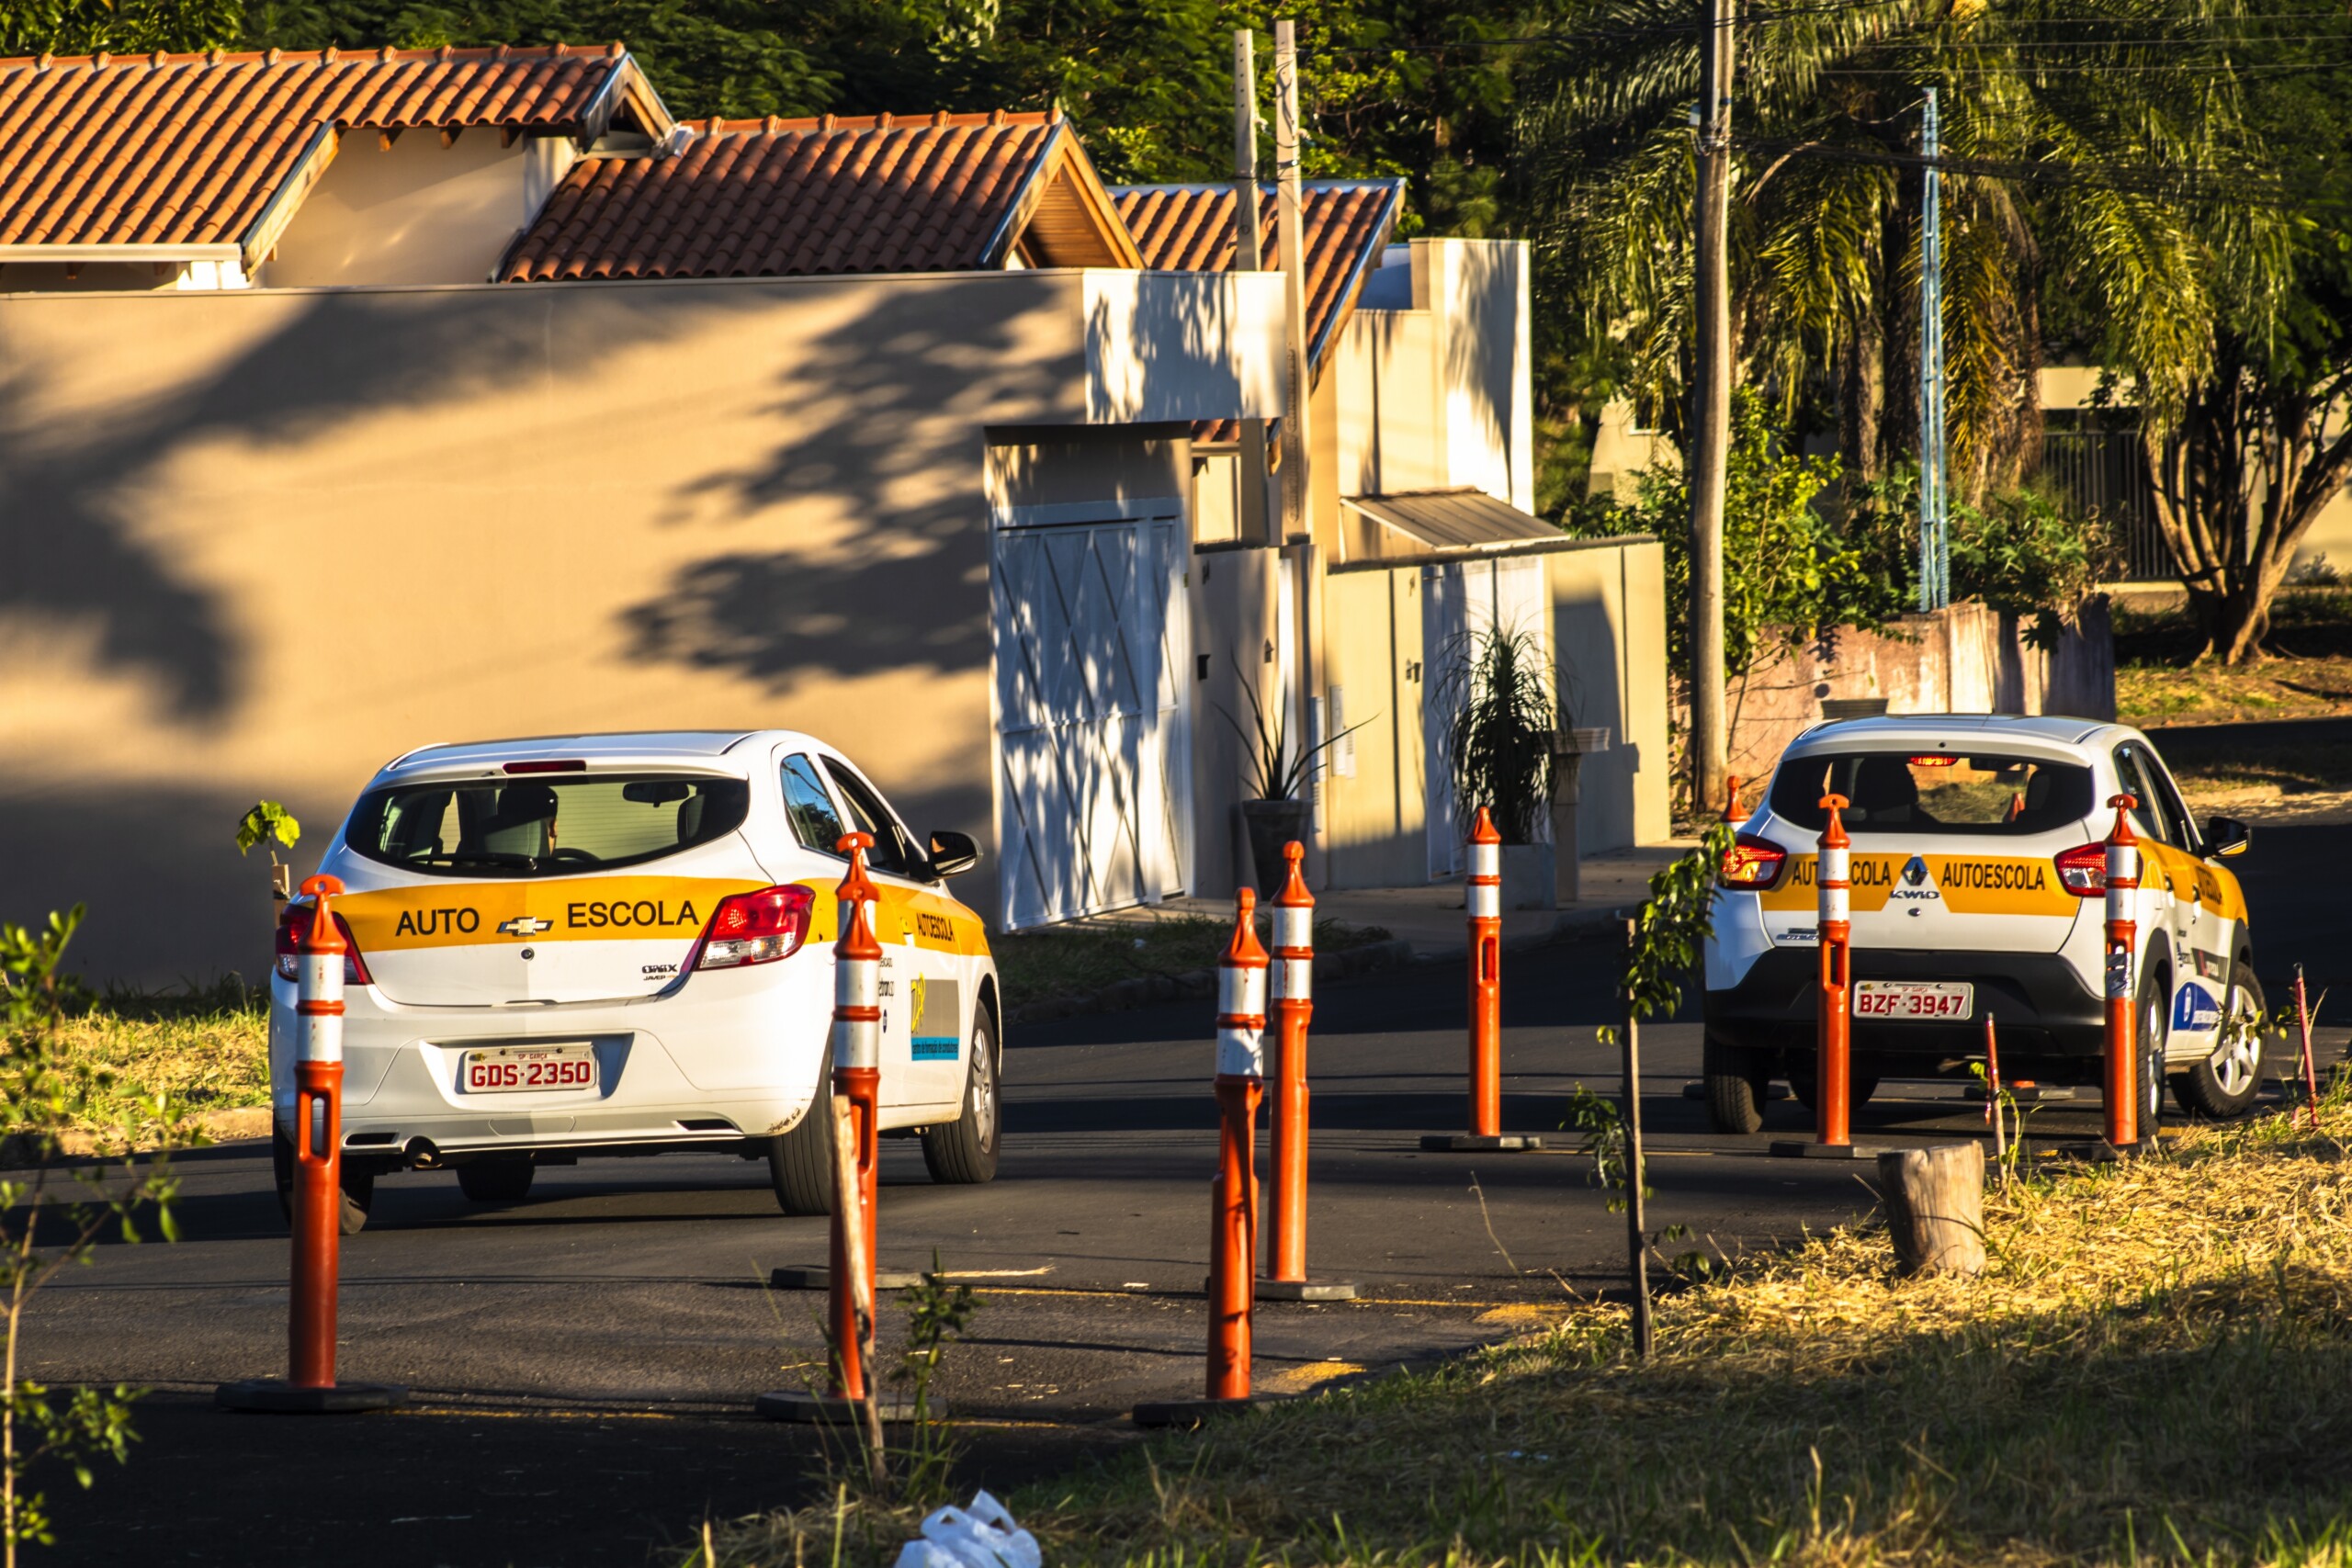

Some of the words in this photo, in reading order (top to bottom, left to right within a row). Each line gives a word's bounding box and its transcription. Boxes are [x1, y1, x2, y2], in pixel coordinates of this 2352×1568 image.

[1792, 861, 1892, 886] AUTCOLA
[1941, 862, 2046, 891] AUTOESCOLA
[1890, 890, 1940, 899] KWID
[395, 908, 480, 937] AUTO
[568, 900, 700, 929] ESCOLA
[916, 912, 956, 943] AUTOESCOLA
[529, 1053, 548, 1061] GARÇA
